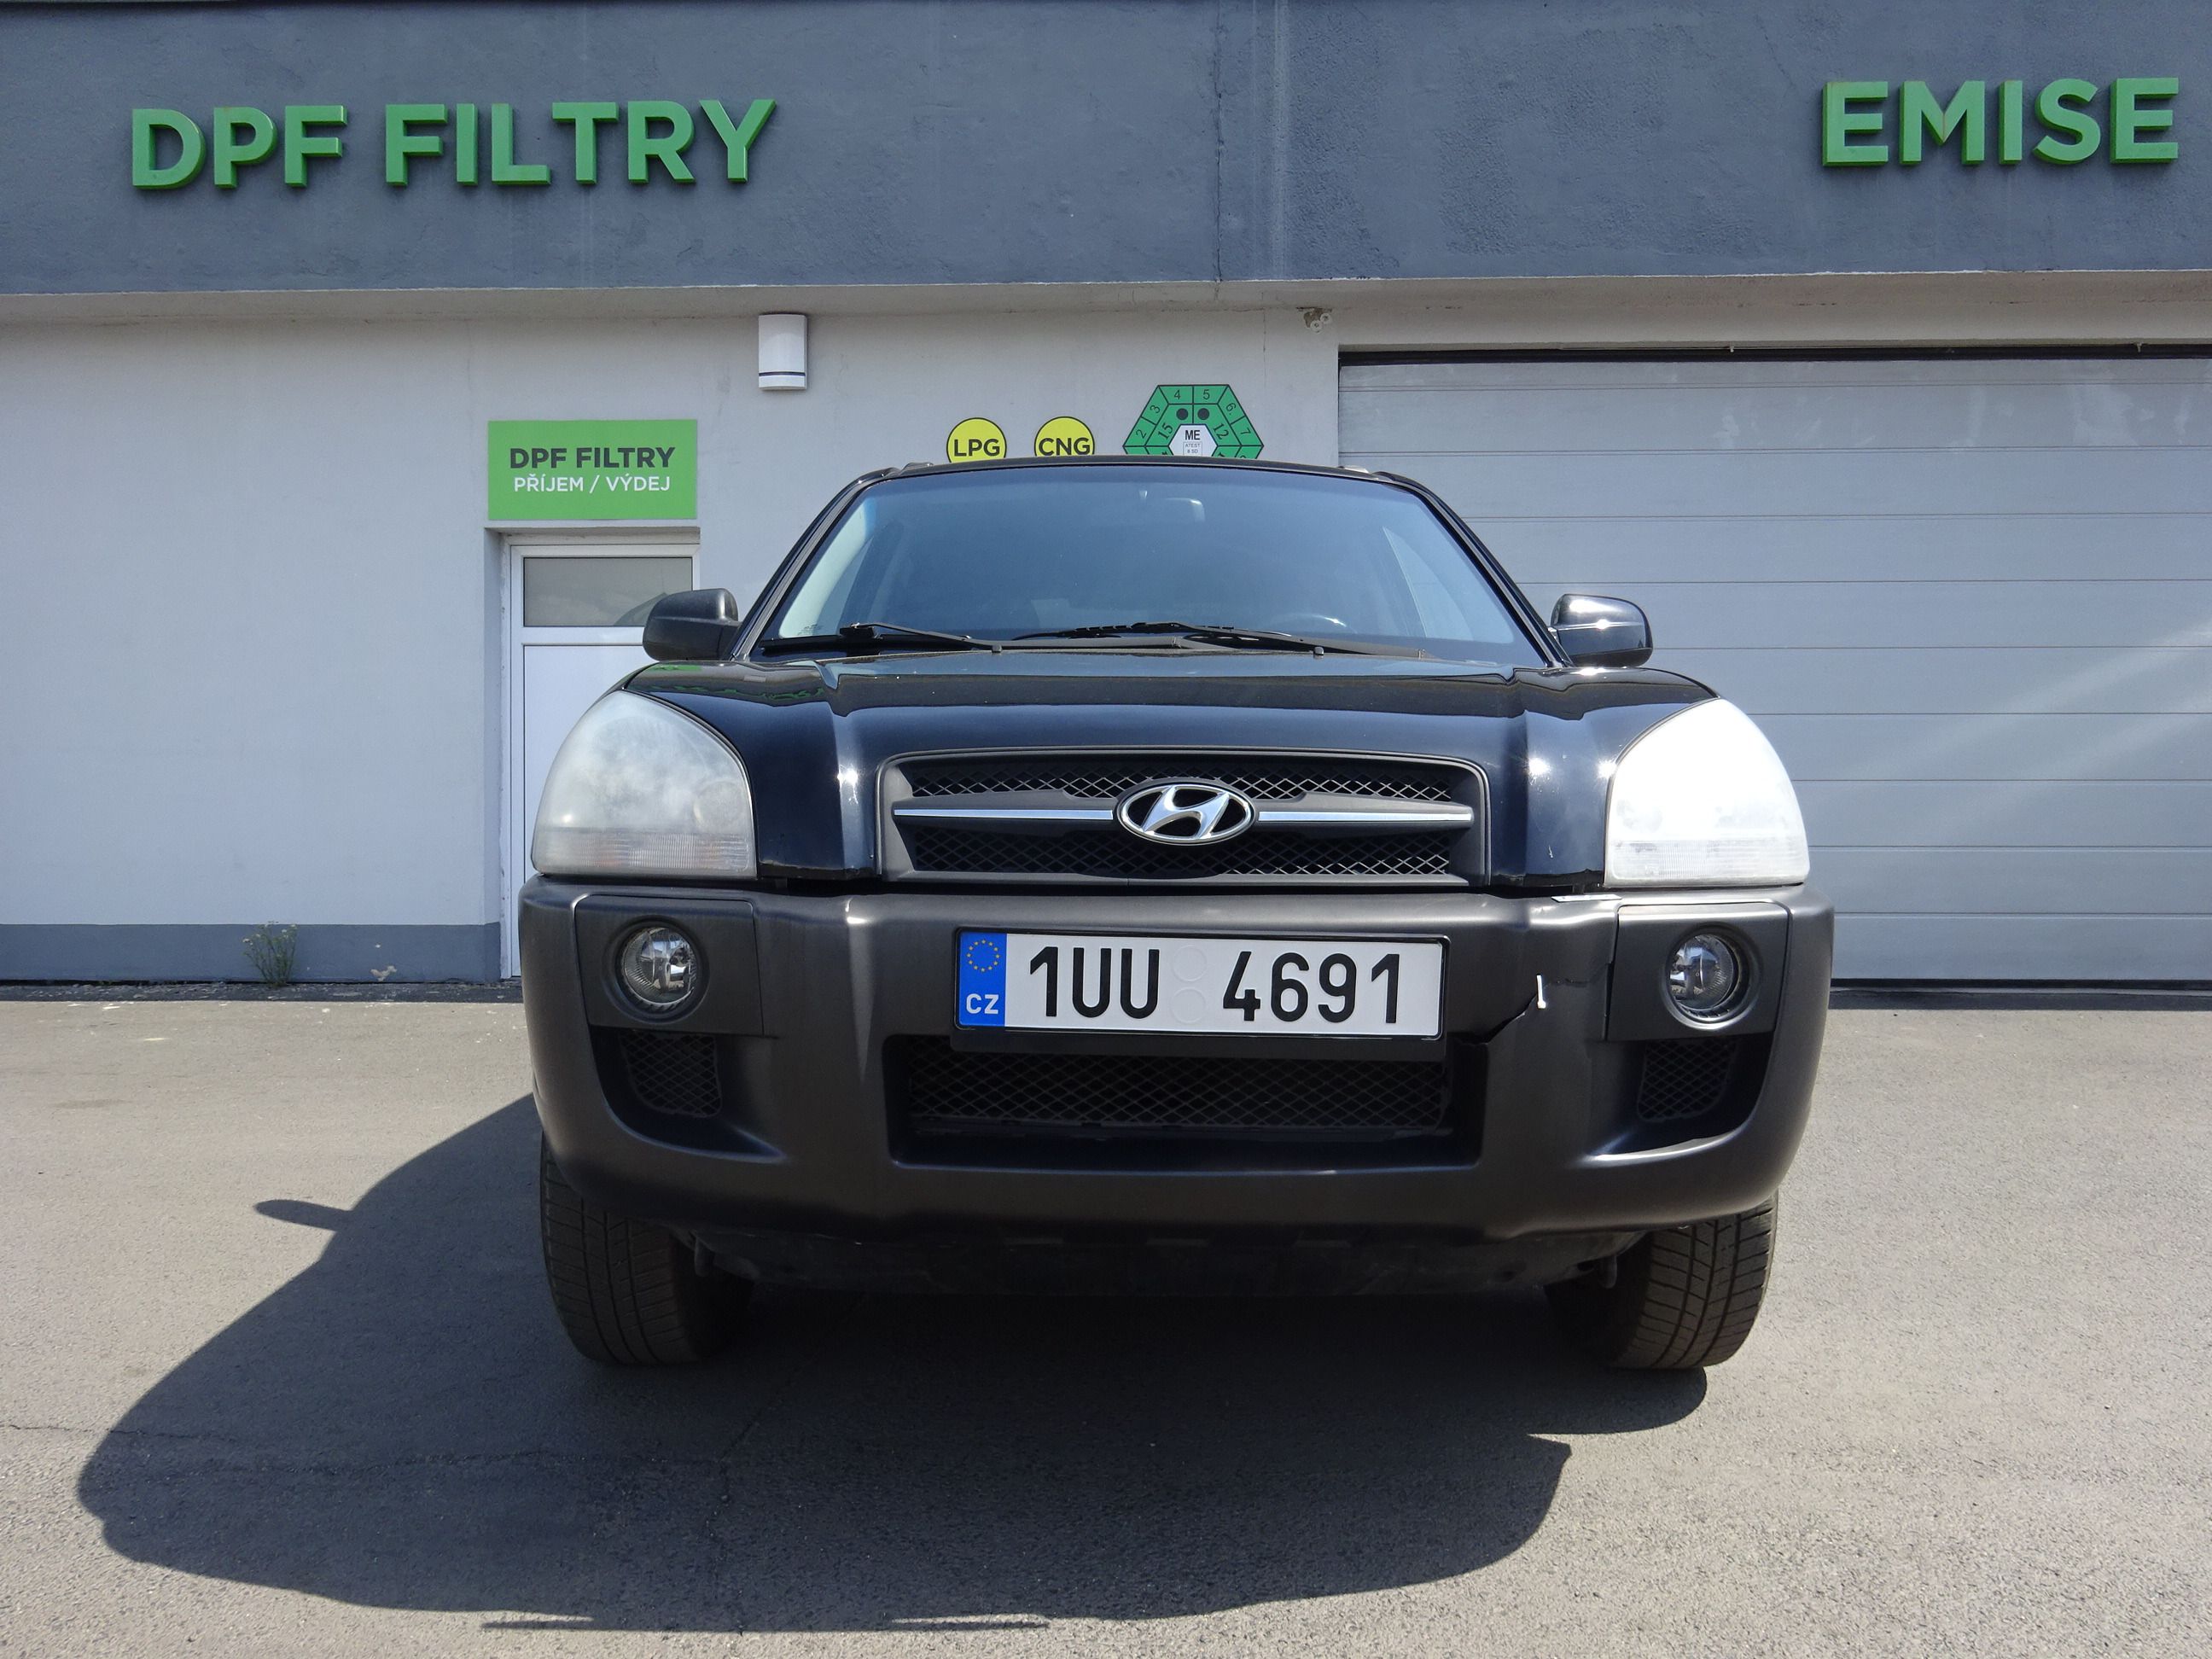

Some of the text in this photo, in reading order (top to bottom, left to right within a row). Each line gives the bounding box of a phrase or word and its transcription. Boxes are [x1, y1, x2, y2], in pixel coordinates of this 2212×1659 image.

[1822, 78, 2180, 166] EMISE
[131, 98, 776, 190] DPF FILTRY
[1173, 389, 1181, 400] 4
[1202, 389, 1210, 400] 5
[1136, 428, 1147, 439] 2
[1185, 429, 1201, 440] ME
[953, 439, 1000, 457] LPG
[1038, 437, 1091, 457] CNG
[509, 447, 676, 469] DPF FILTRY
[514, 474, 671, 494] PŘÍJEM / VÝDEJ
[1029, 946, 1400, 1024] 1UU 4691
[966, 993, 998, 1015] CZ
